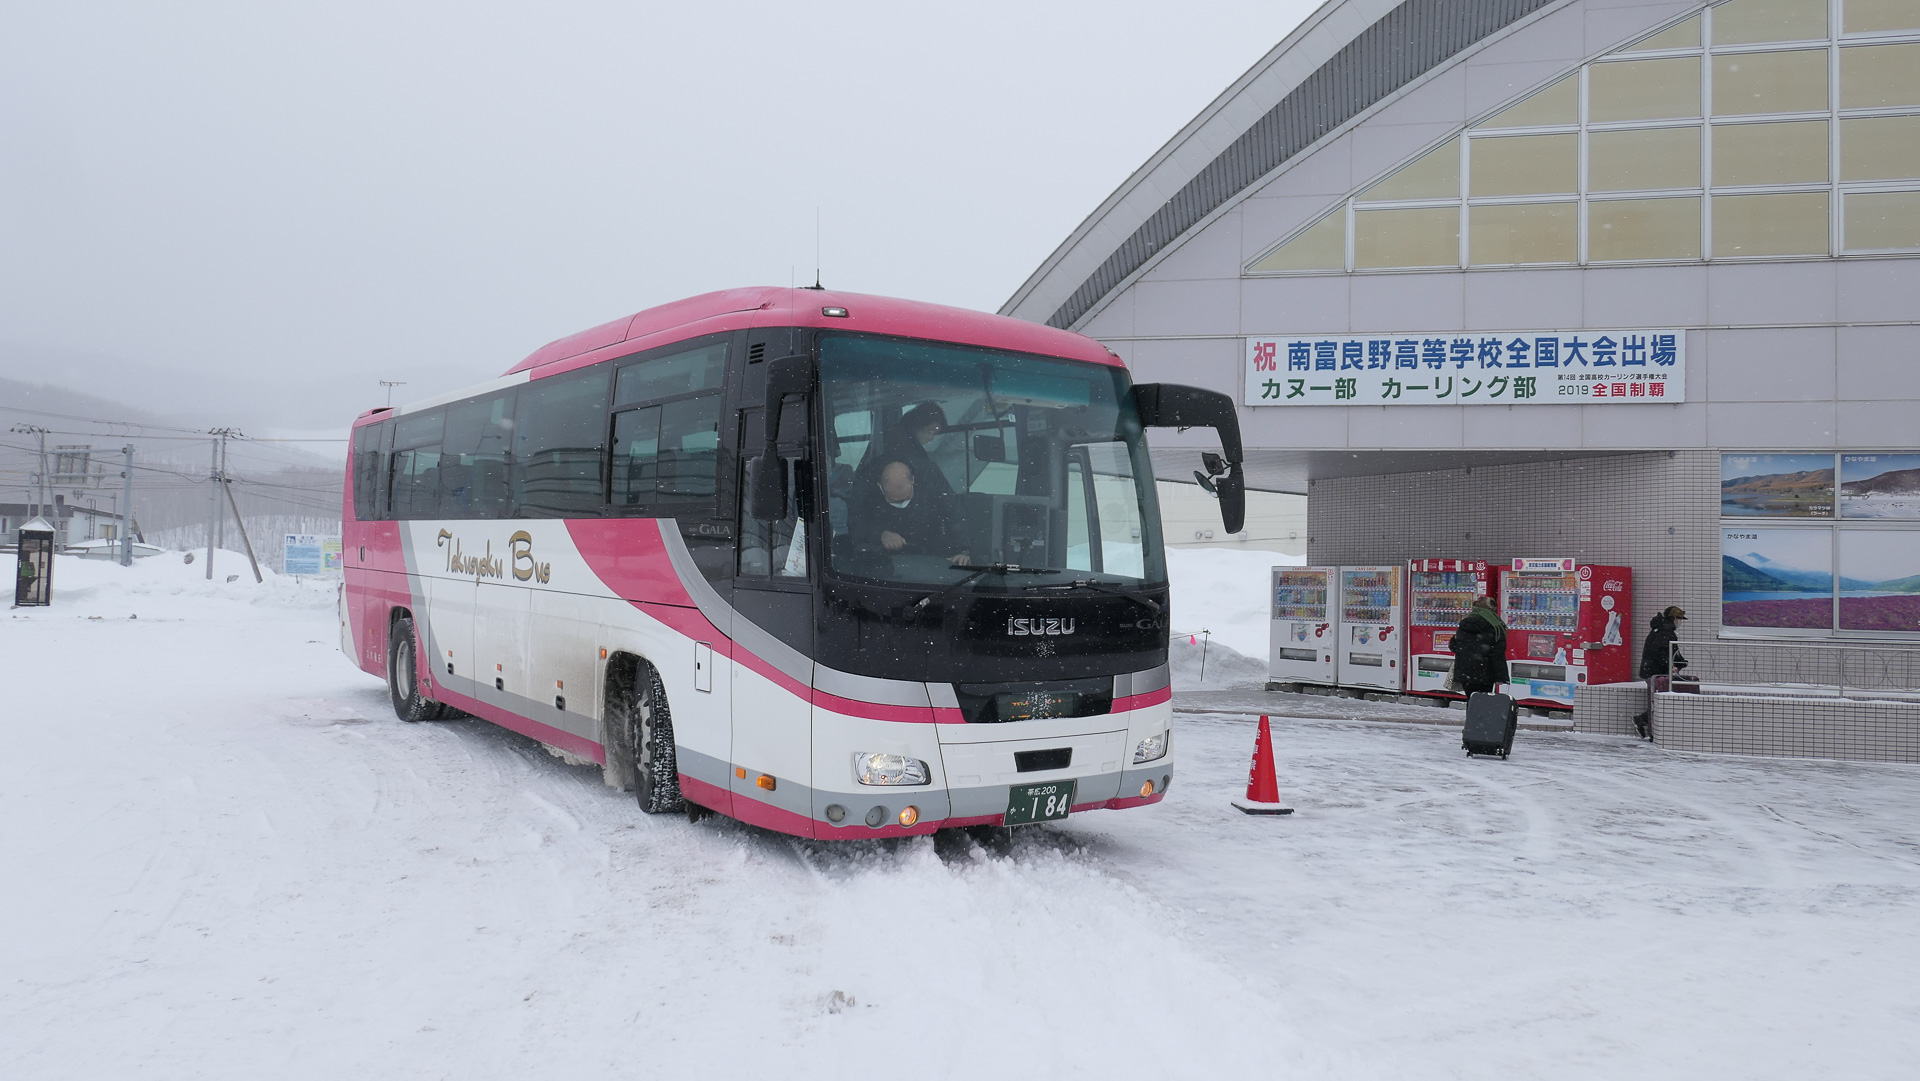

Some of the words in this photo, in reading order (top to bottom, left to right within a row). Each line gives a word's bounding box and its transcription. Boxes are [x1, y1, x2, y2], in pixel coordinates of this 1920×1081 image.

[1254, 341, 1277, 372] 祝
[1287, 334, 1677, 371] 南富良野高等学校全国大会出場
[1261, 376, 1358, 400] カヌー部
[1381, 375, 1538, 400] カーリング部
[1559, 385, 1588, 396] 2019
[1591, 382, 1665, 397] 全国制覇
[699, 523, 731, 535] GALA
[437, 528, 503, 586] Takusyoku
[508, 530, 551, 584] Bus
[1007, 617, 1076, 636] ISUZU
